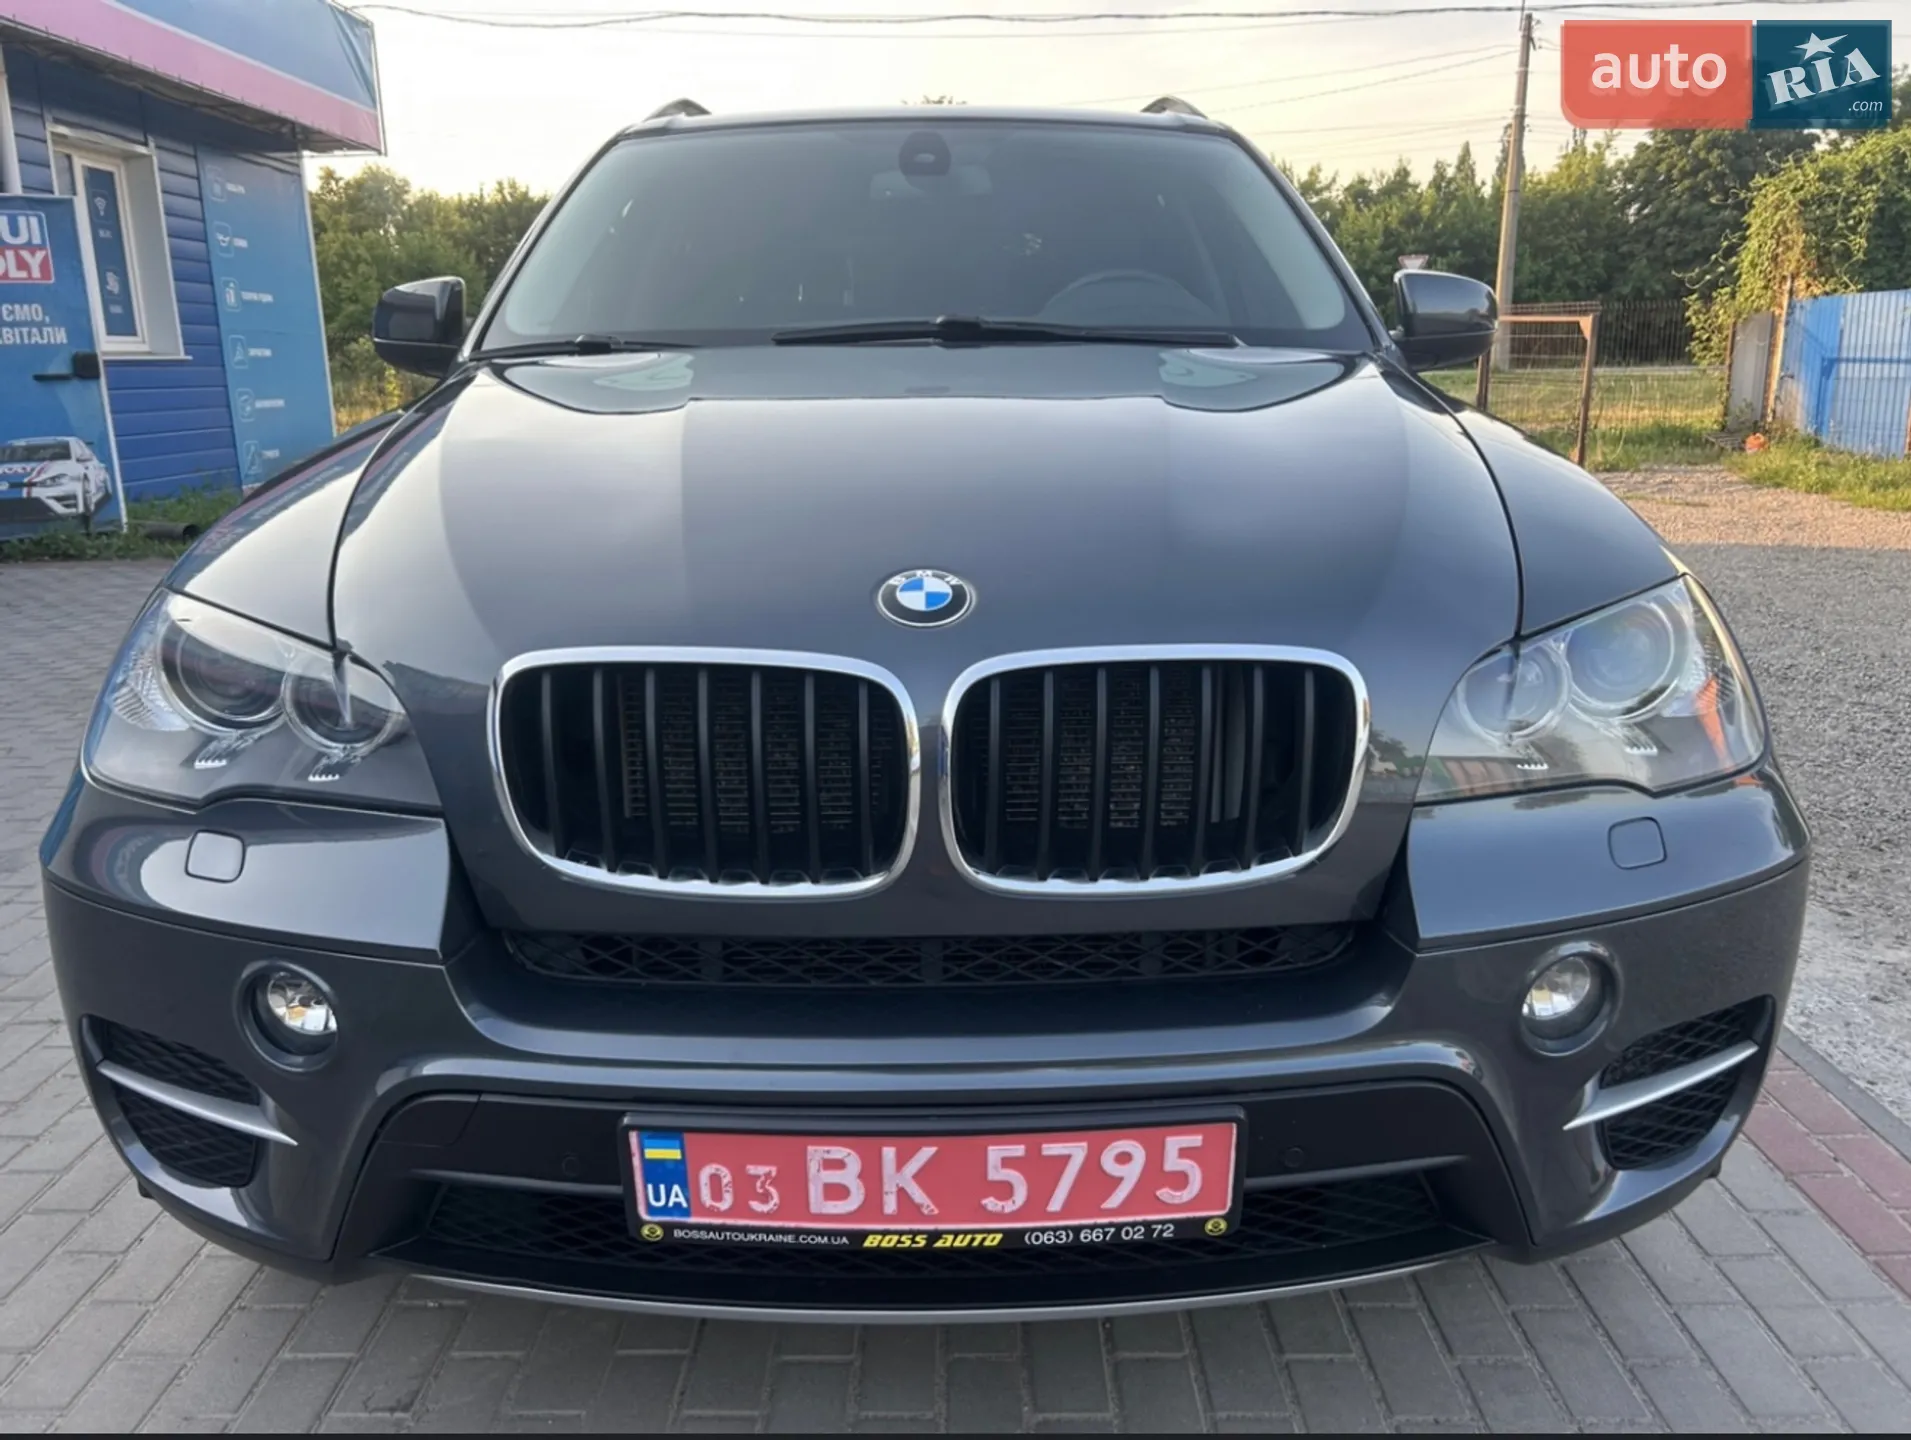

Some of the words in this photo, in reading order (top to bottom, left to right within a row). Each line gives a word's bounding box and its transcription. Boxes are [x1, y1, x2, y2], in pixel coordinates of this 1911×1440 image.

[0, 248, 46, 279] LY
[0, 326, 68, 345] ВІТАЛИ
[700, 1163, 780, 1214] 03
[806, 1145, 939, 1215] BK
[981, 1134, 1203, 1213] 5795
[648, 1183, 688, 1208] UA
[673, 1228, 850, 1245] BOSSAUTOUKRAINE.COM.UA
[862, 1233, 928, 1248] BOSS
[932, 1232, 1004, 1248] AUTO
[1024, 1231, 1073, 1246] (063)
[1080, 1227, 1115, 1243] 667
[1120, 1226, 1145, 1241] 02
[1151, 1223, 1175, 1238] 72
